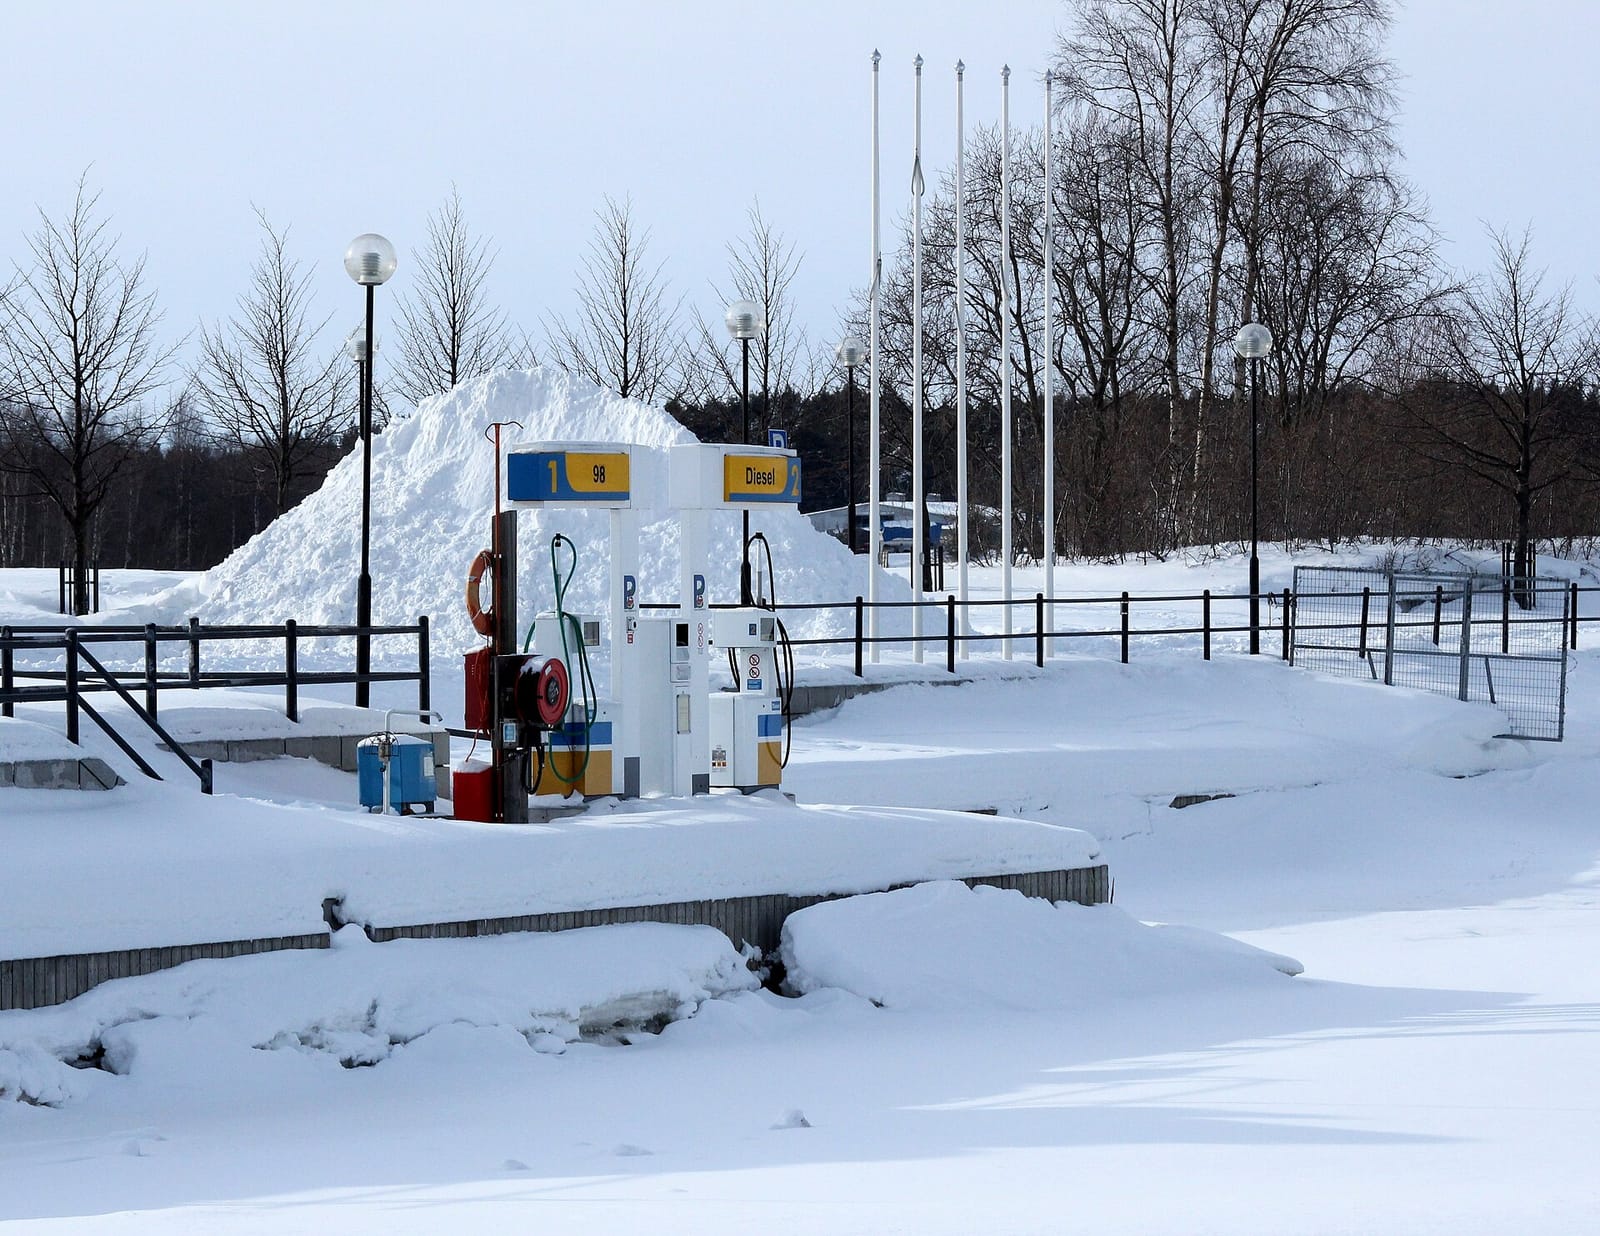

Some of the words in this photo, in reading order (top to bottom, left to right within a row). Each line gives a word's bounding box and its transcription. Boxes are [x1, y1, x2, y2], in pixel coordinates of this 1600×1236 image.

[547, 460, 557, 493] 1
[592, 464, 606, 483] 98
[745, 466, 775, 486] Diesel
[791, 465, 800, 496] 2
